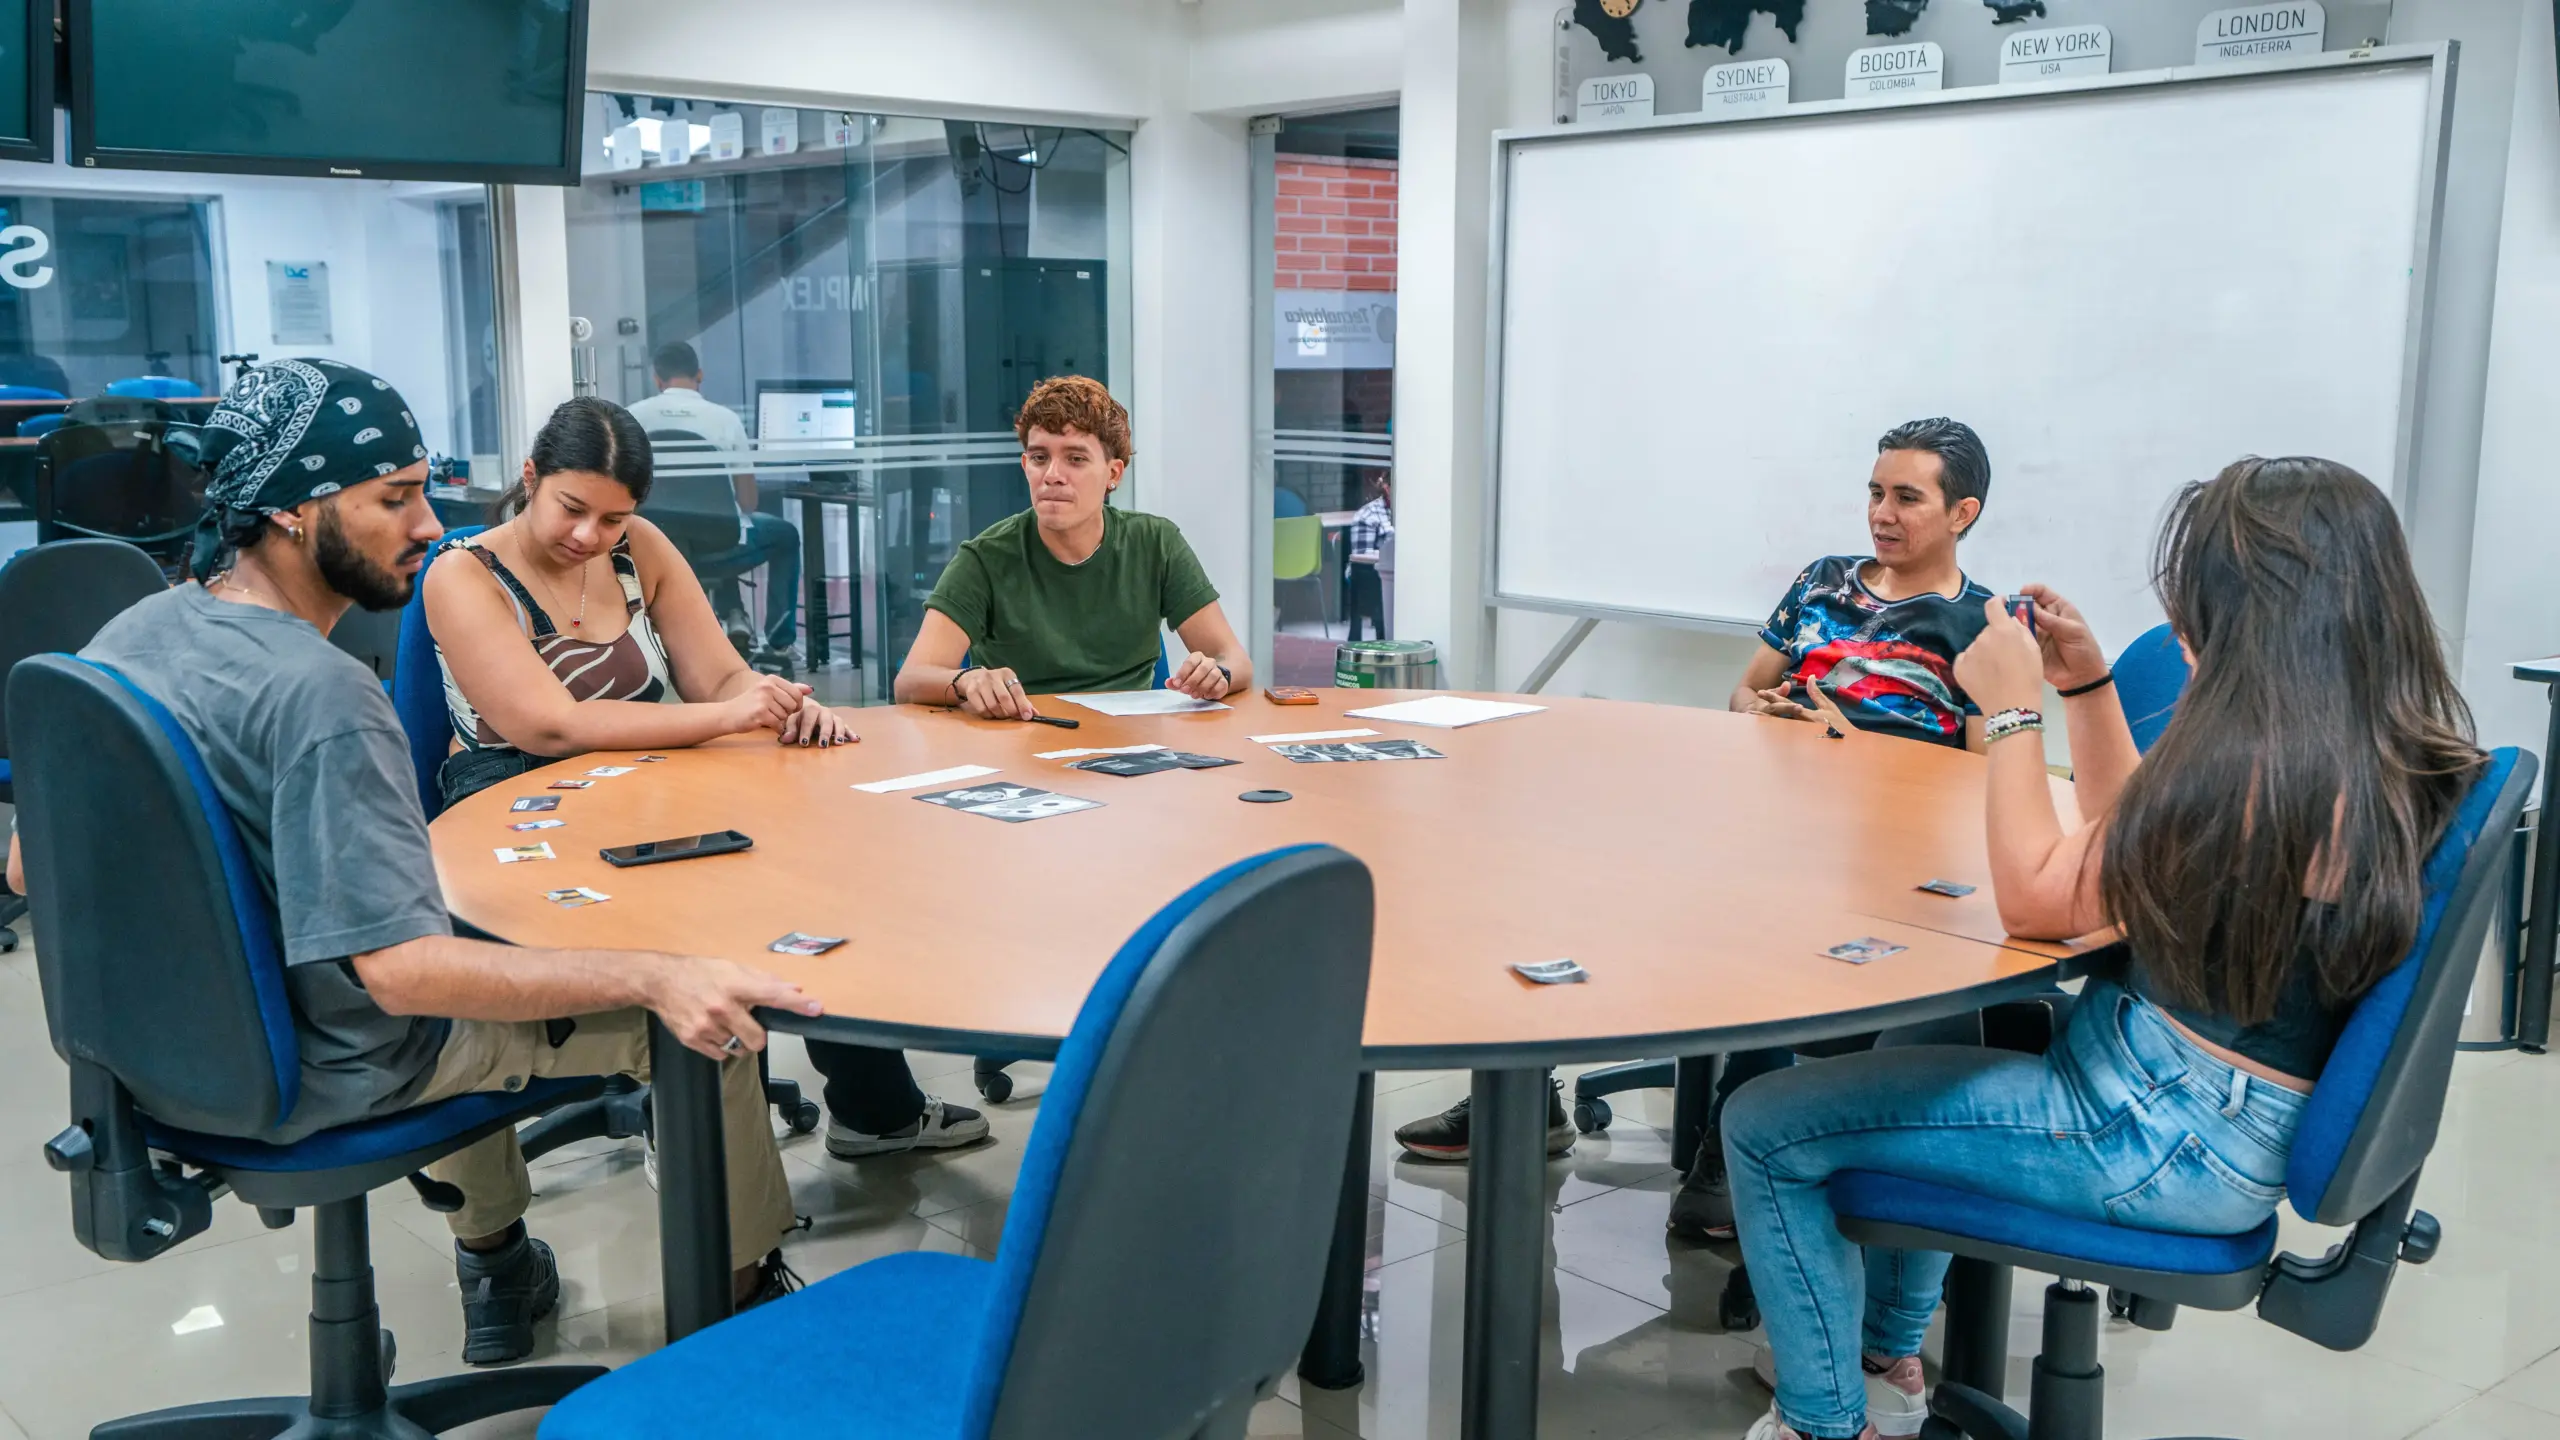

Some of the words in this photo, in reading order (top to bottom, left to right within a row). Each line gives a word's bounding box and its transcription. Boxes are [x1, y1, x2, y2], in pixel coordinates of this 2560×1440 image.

[2218, 8, 2305, 37] LONDON
[2011, 36, 2050, 57] NEW
[2055, 31, 2101, 53] YORK
[2220, 39, 2292, 57] INGLATERRA
[1860, 44, 1927, 73] BOGOTÁ
[1716, 65, 1775, 88] SYDNEY
[2040, 62, 2061, 75] USA
[1592, 80, 1637, 101] TOKYO
[1869, 77, 1916, 91] COLOMBIA
[1722, 91, 1767, 104] AUSTRALIA
[1601, 104, 1625, 116] JAPÓN
